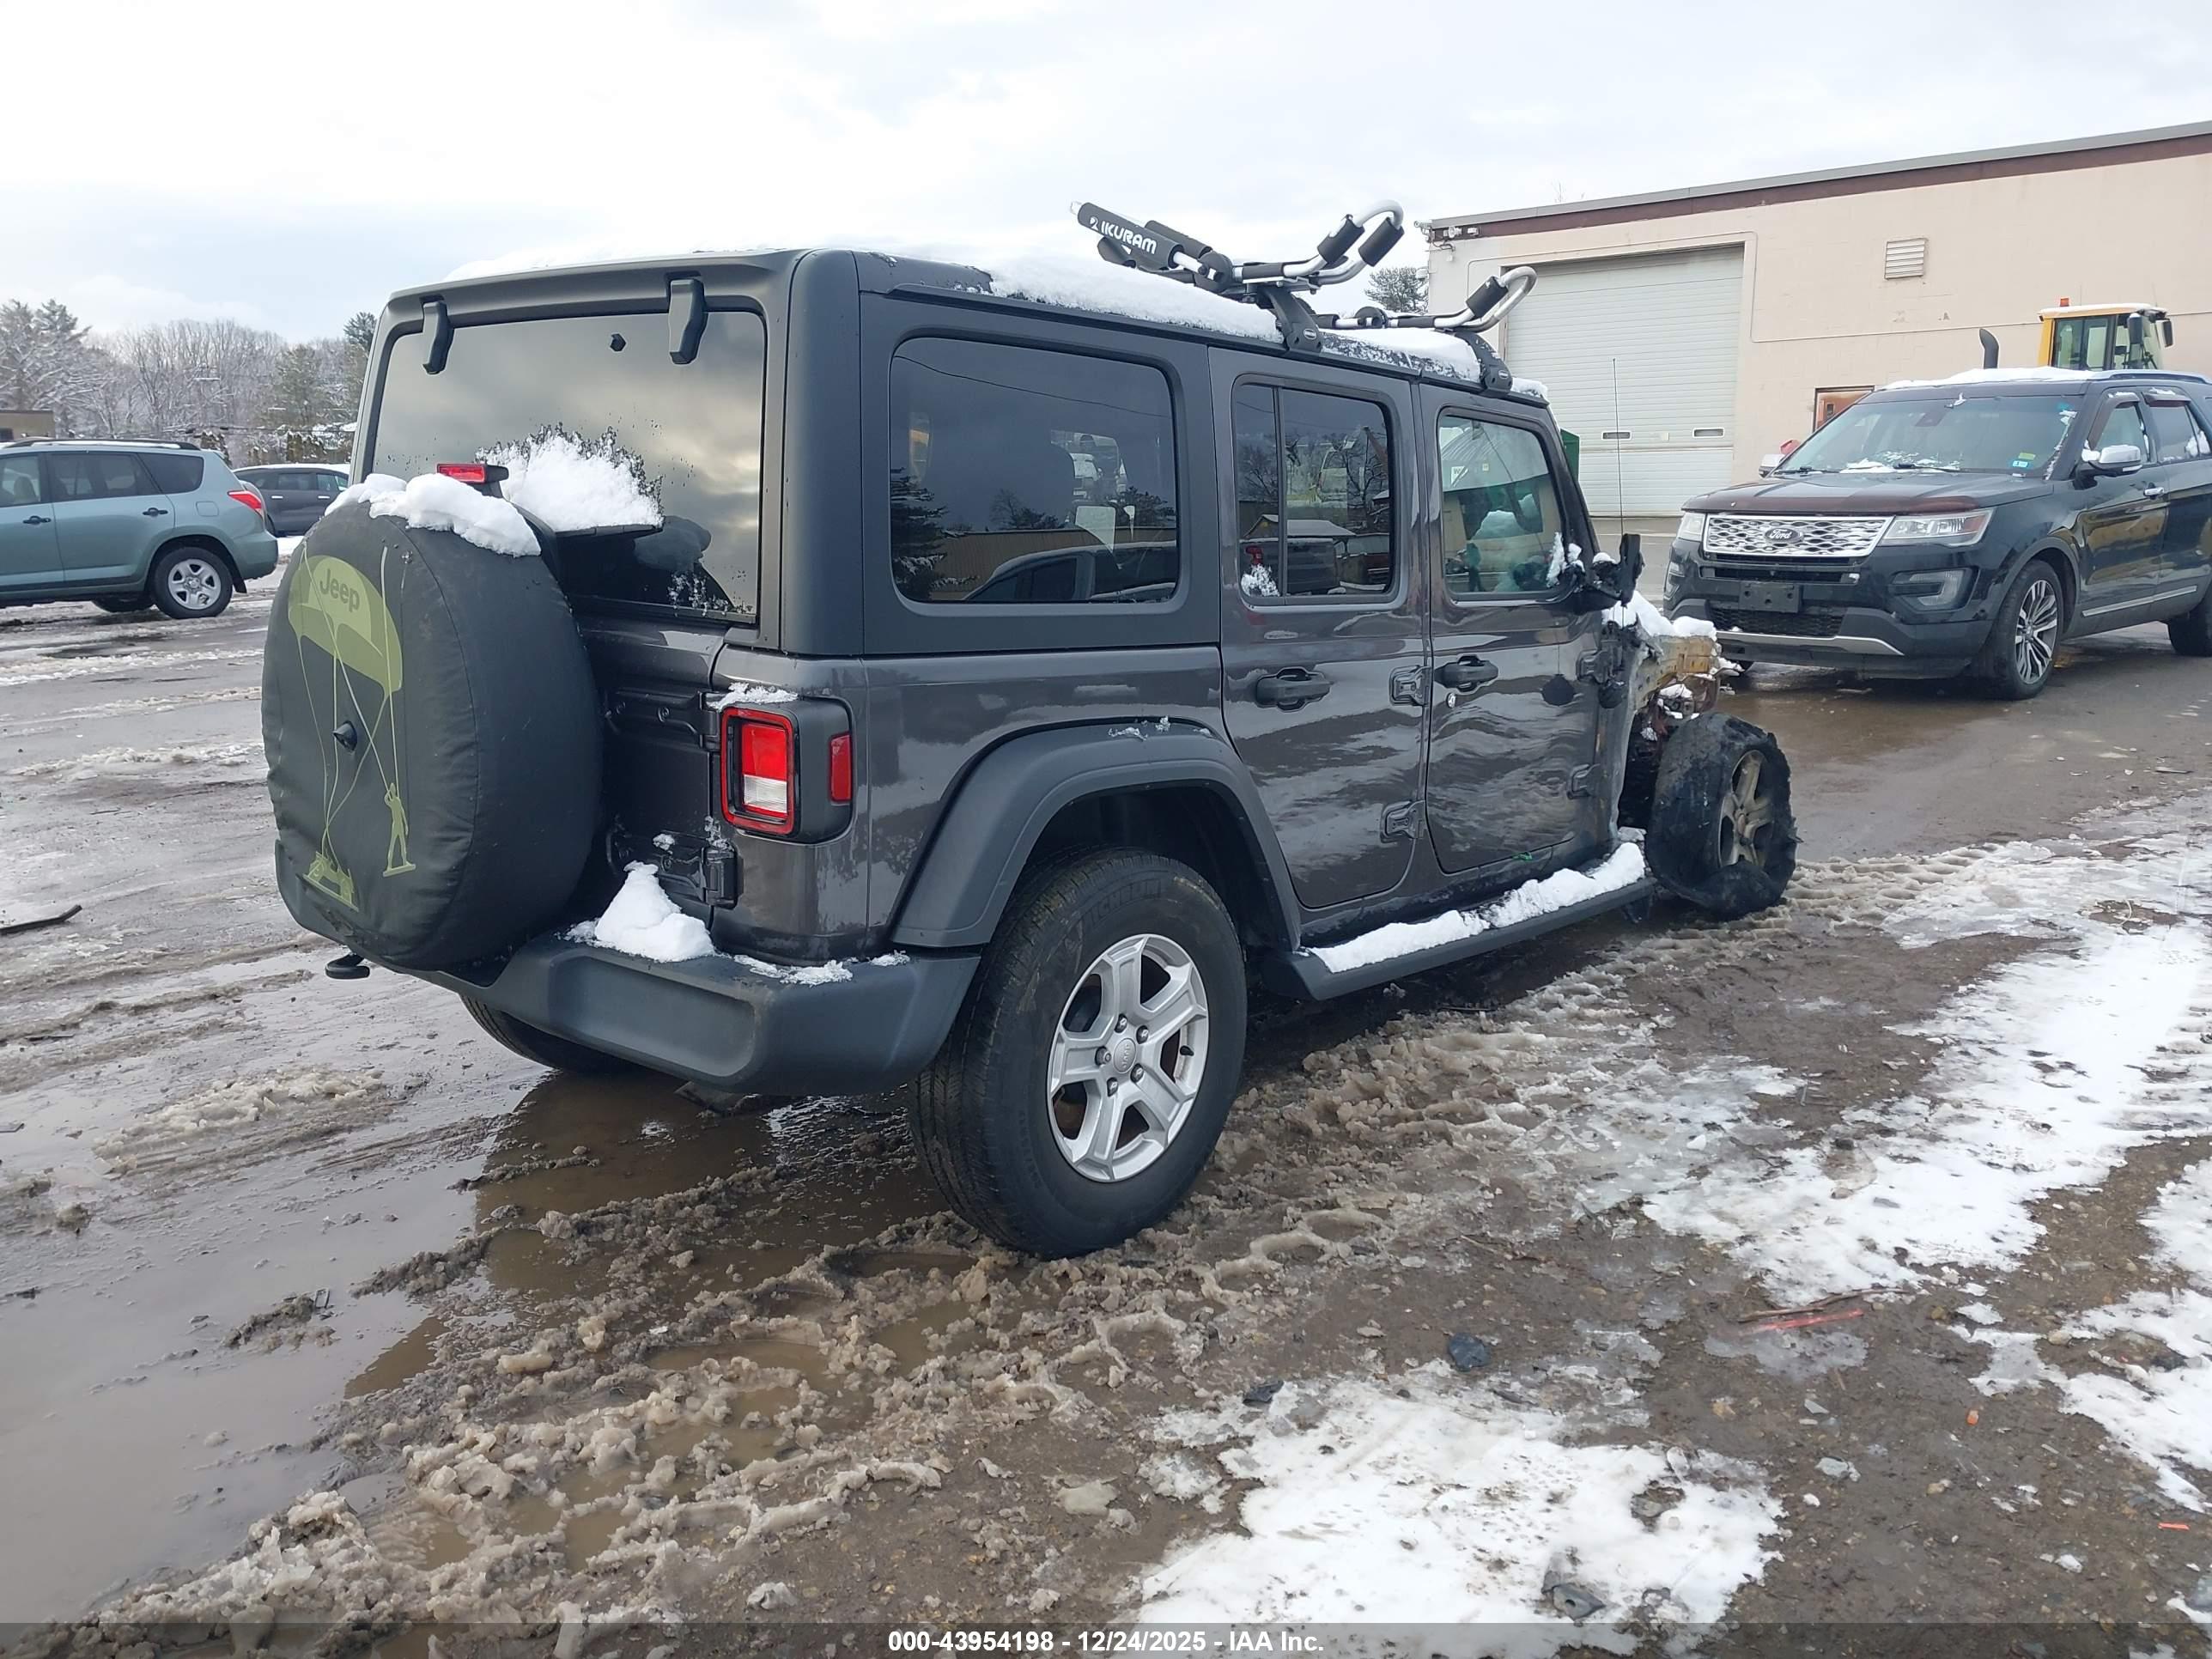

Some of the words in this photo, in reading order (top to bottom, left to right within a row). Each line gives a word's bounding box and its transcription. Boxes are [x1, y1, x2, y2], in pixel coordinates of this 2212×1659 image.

[1101, 221, 1157, 254] IKURAM
[1769, 529, 1792, 539] Ford
[319, 568, 360, 612] Jeep
